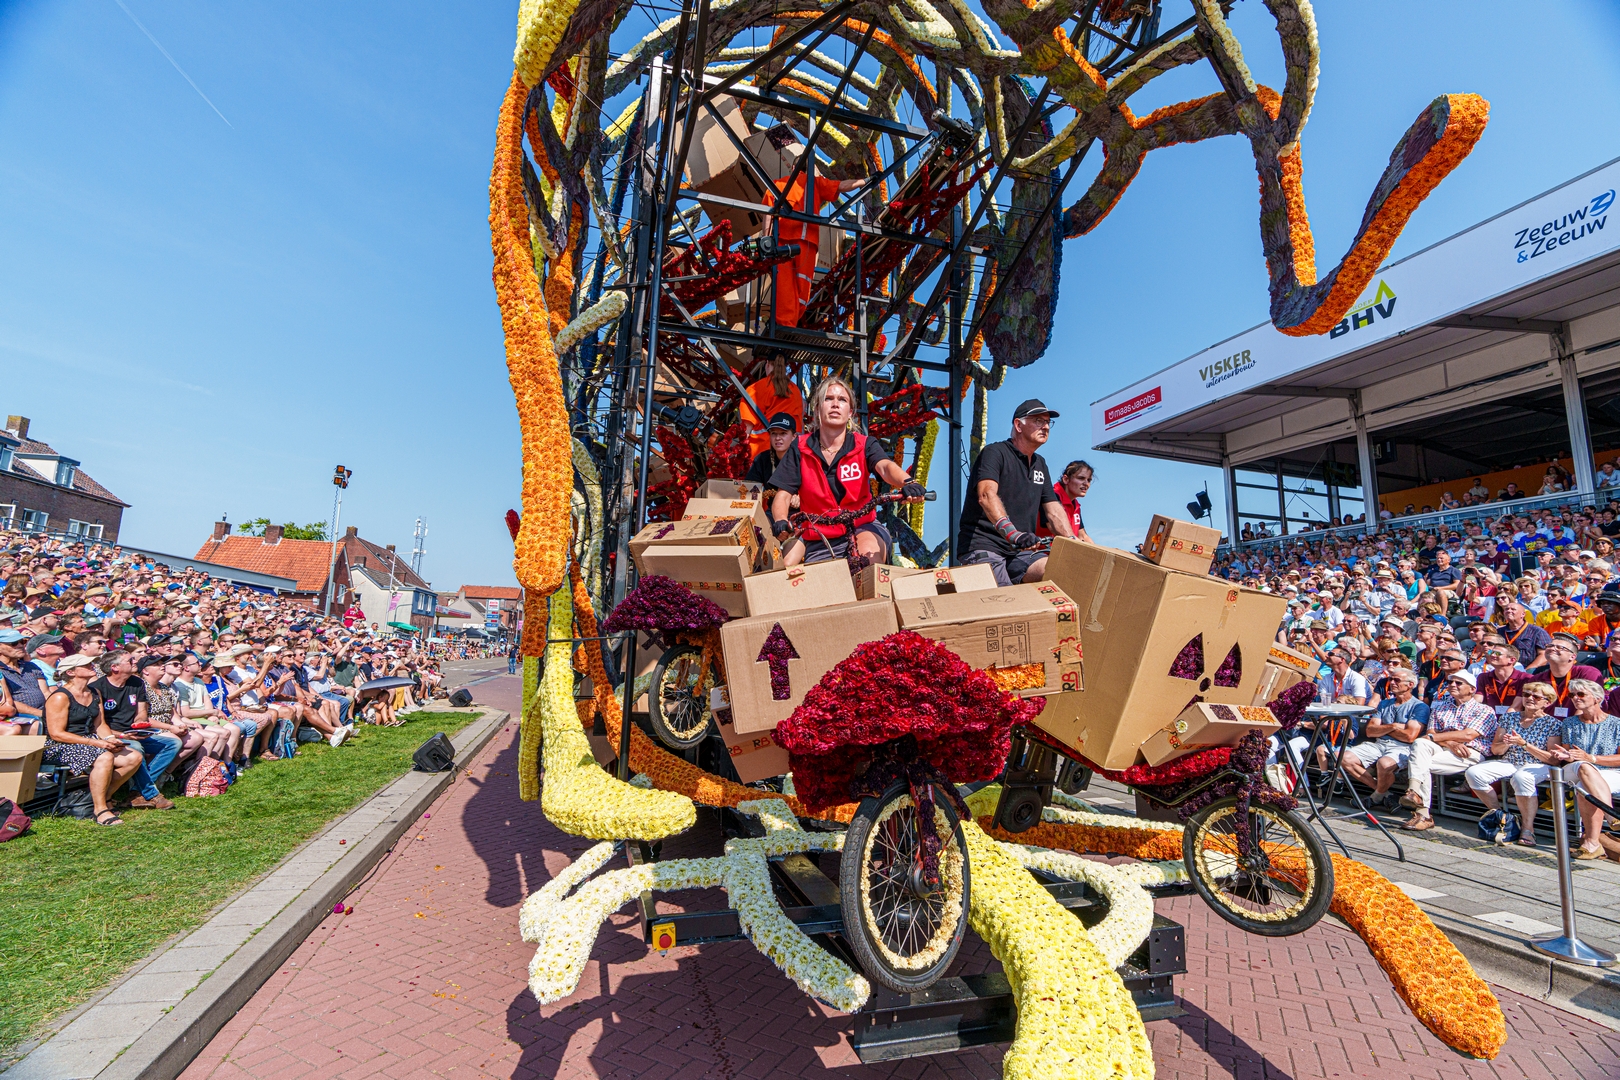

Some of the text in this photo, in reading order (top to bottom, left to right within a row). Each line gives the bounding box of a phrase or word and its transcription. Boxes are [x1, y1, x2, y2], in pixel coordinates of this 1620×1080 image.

[1514, 206, 1588, 249] Zeeuw
[1531, 215, 1607, 259] Zeeuw
[1329, 296, 1398, 340] BHV
[1199, 349, 1251, 382] VISKER
[840, 462, 862, 482] RB
[1033, 470, 1045, 484] RB
[1170, 539, 1184, 550] RB
[1190, 543, 1204, 555] RB
[878, 566, 890, 584] RB
[1056, 603, 1076, 623] RB
[1061, 671, 1079, 692] RB
[752, 736, 771, 750] RB
